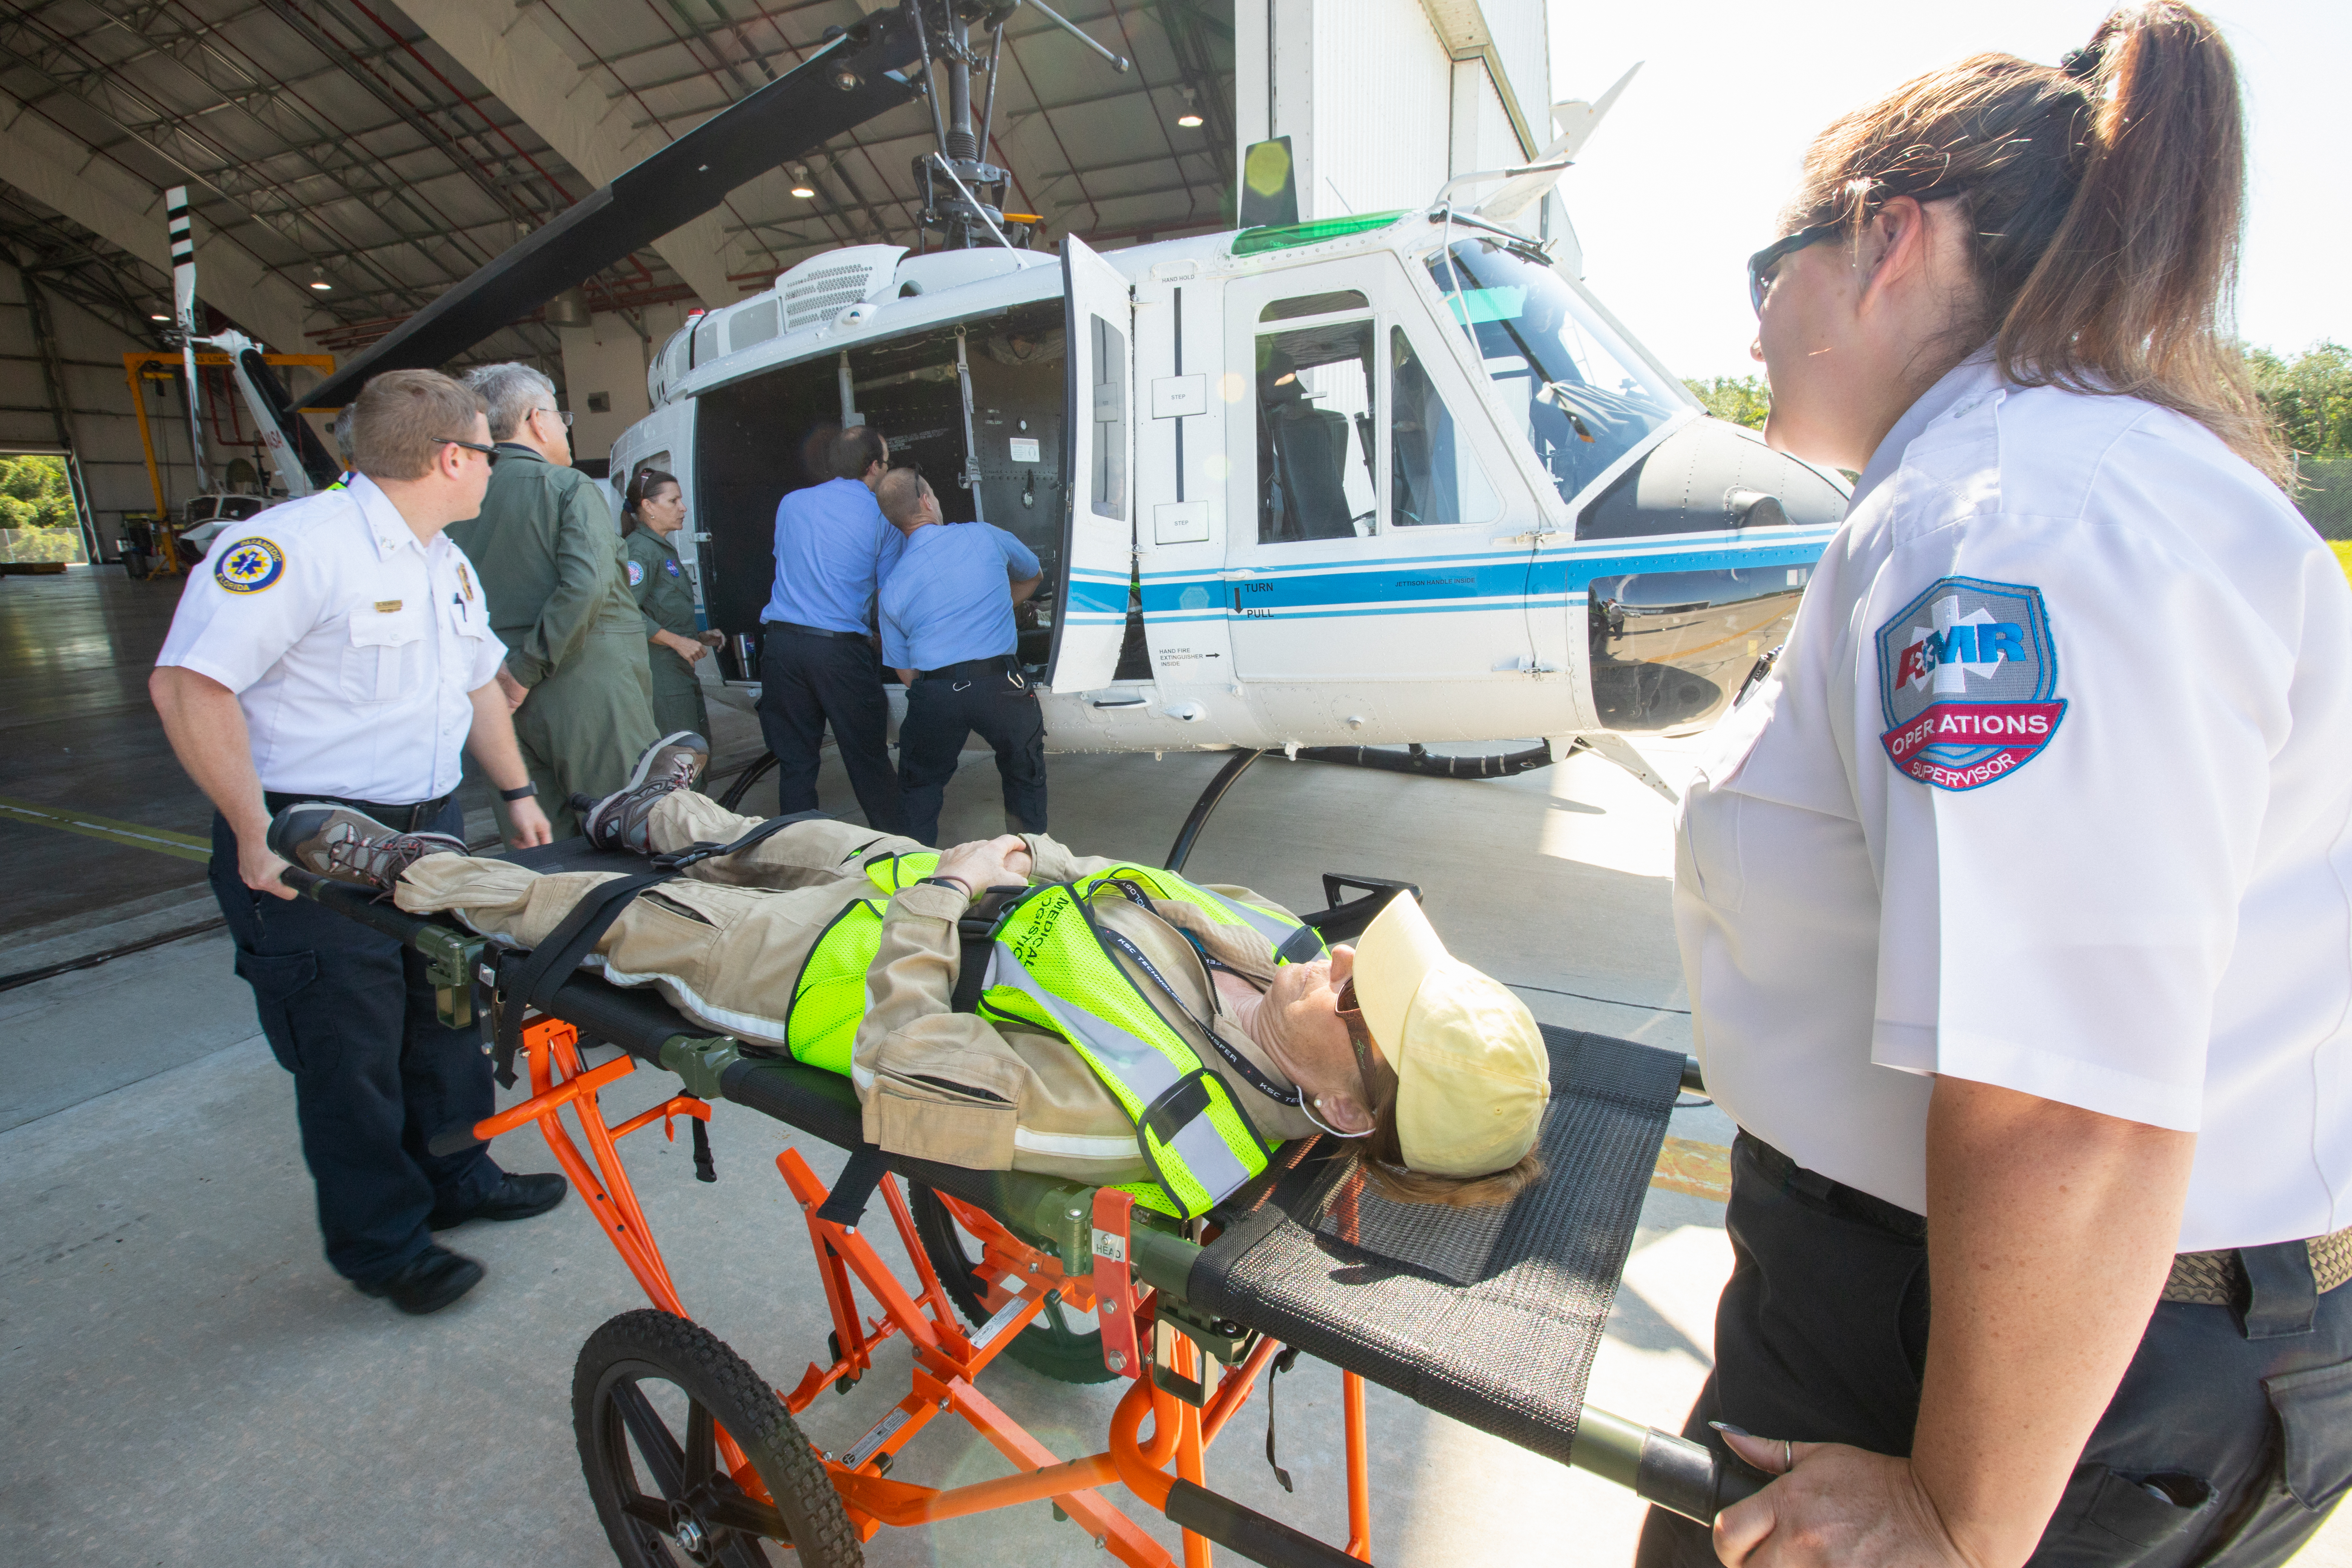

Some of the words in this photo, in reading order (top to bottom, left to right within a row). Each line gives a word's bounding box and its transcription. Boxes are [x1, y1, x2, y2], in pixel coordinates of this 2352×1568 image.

[240, 539, 282, 562] PARAMEDIC
[216, 573, 250, 591] FLORIDA
[1245, 582, 1274, 593] TURN
[1247, 609, 1274, 618] PULL
[1895, 622, 2026, 690] AMR
[1892, 714, 2048, 755] OPERATIONS
[1911, 753, 2016, 786] SUPERVISOR
[1014, 897, 1052, 960] OGISTIC
[1023, 897, 1069, 967] MEDICAL
[1117, 939, 1136, 954] KSC
[1260, 1082, 1281, 1098] KSC
[1096, 1243, 1121, 1259] HEAD
[978, 1327, 990, 1338] FLAMOR
